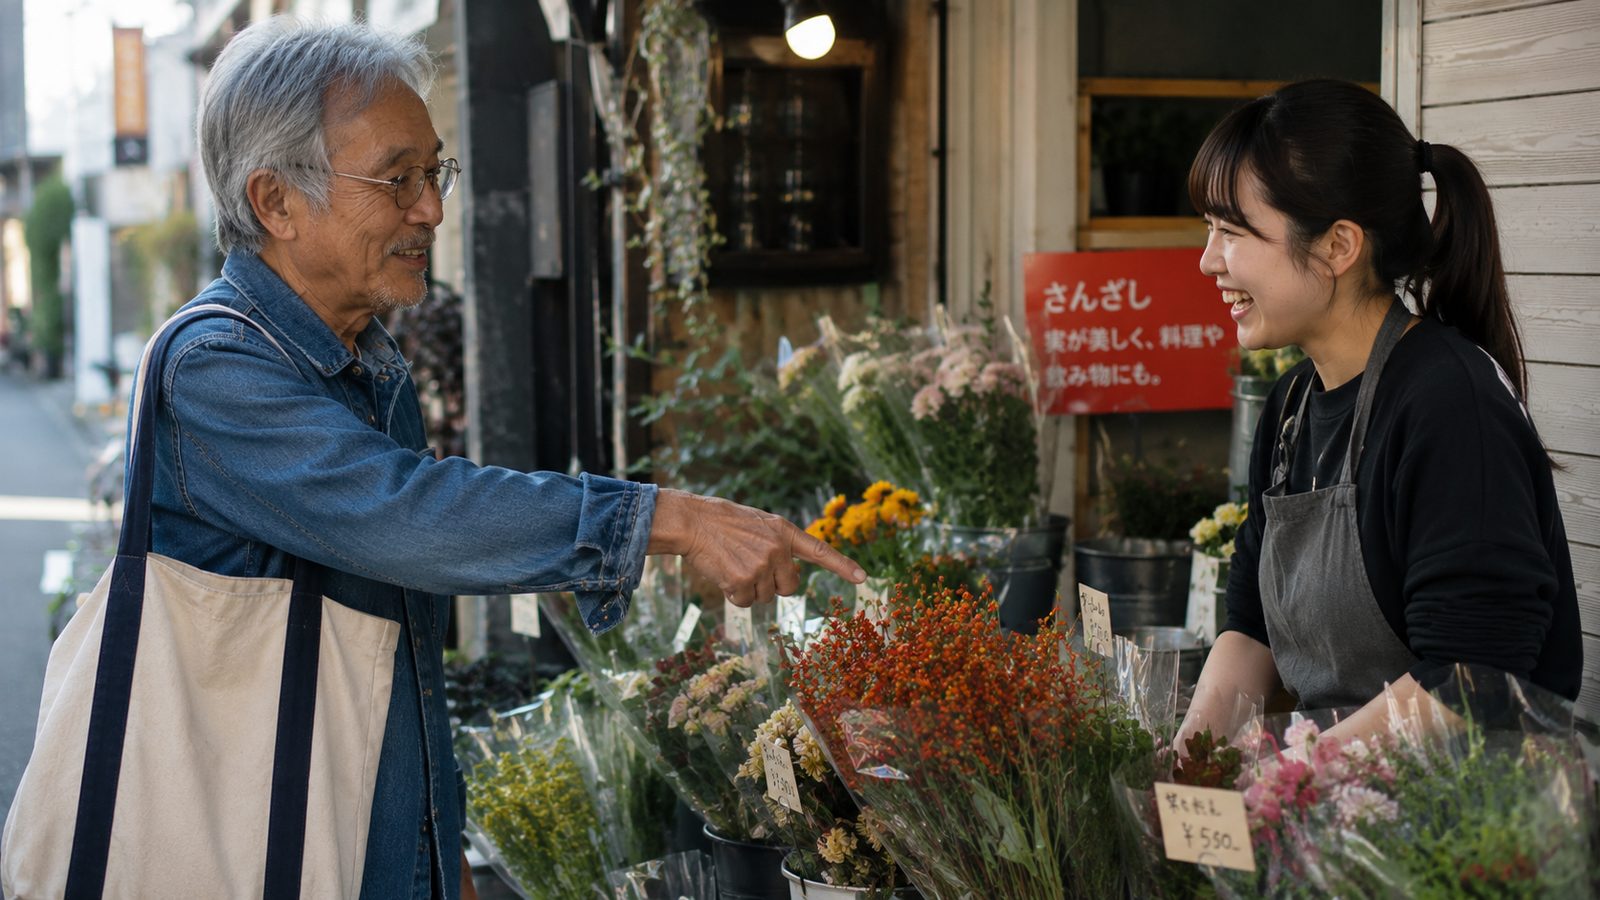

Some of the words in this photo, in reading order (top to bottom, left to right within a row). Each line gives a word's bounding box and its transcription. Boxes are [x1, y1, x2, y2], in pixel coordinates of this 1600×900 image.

[1043, 278, 1152, 313] さんざし
[1044, 324, 1225, 352] 実が美しく、料理や
[1045, 362, 1161, 388] 飲み物にも。
